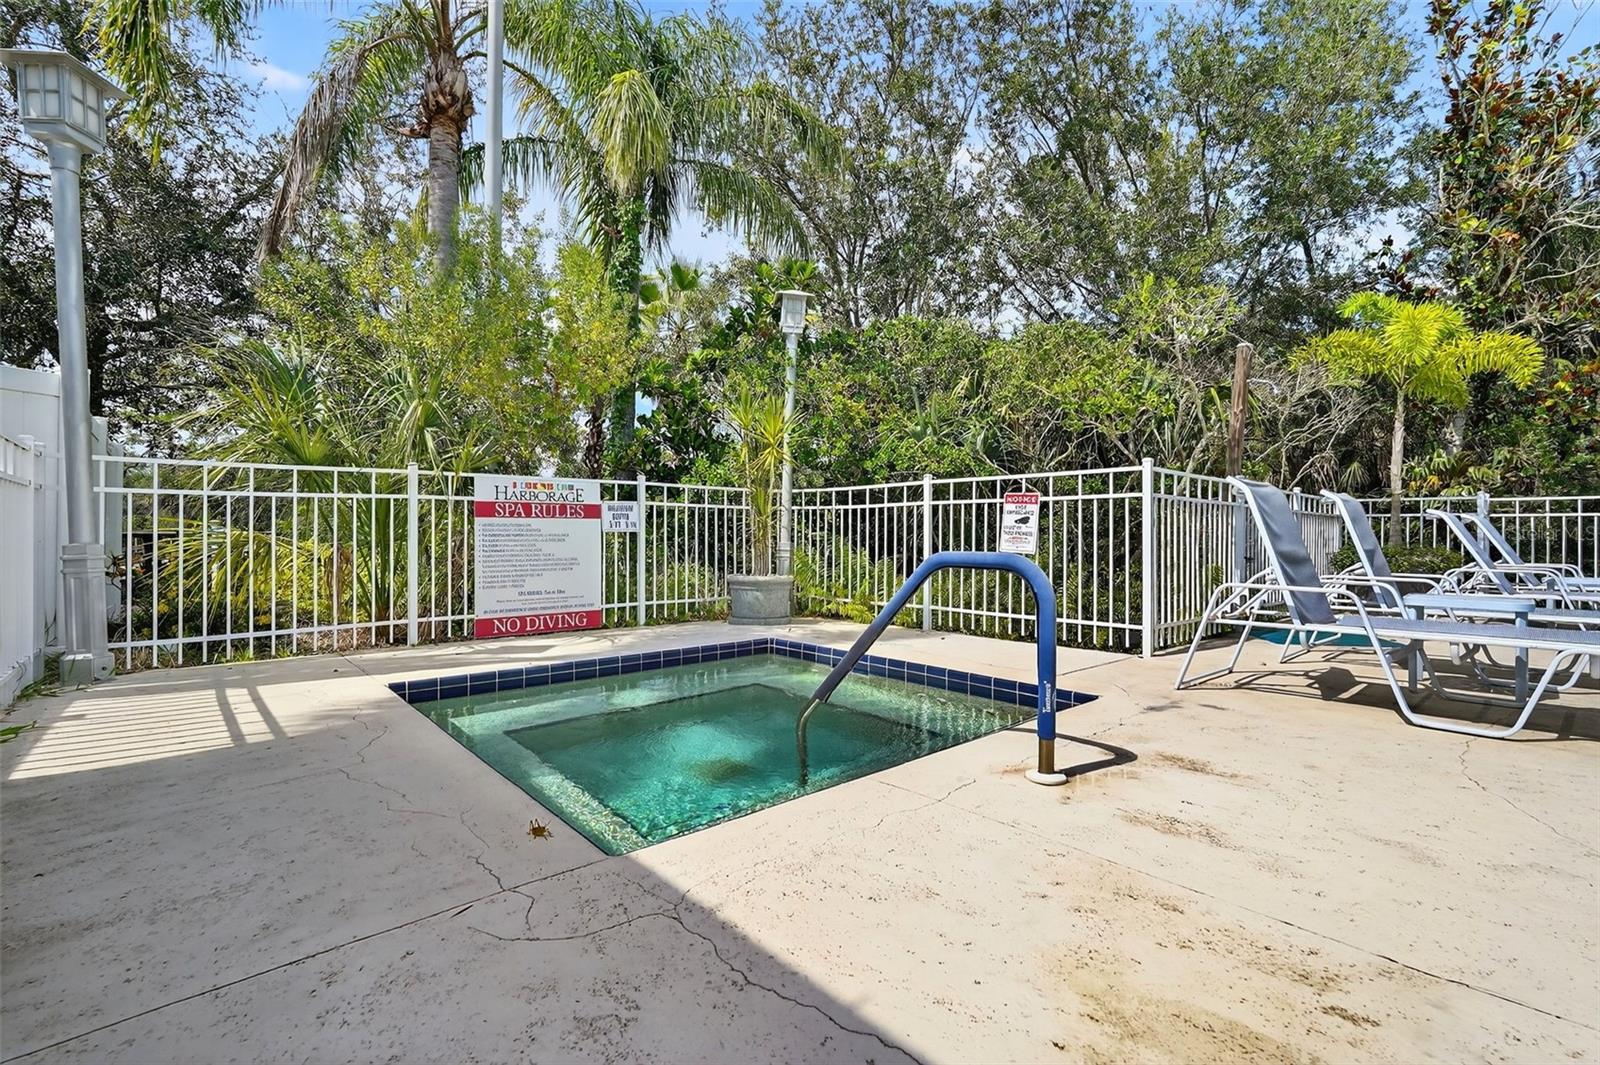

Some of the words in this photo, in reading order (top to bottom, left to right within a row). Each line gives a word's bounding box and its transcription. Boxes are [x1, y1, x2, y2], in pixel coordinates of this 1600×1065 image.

[494, 485, 585, 502] HARBORAGE
[495, 502, 525, 517] SPA
[531, 503, 585, 518] RULES
[493, 618, 520, 634] NO
[526, 612, 587, 631] DIVING
